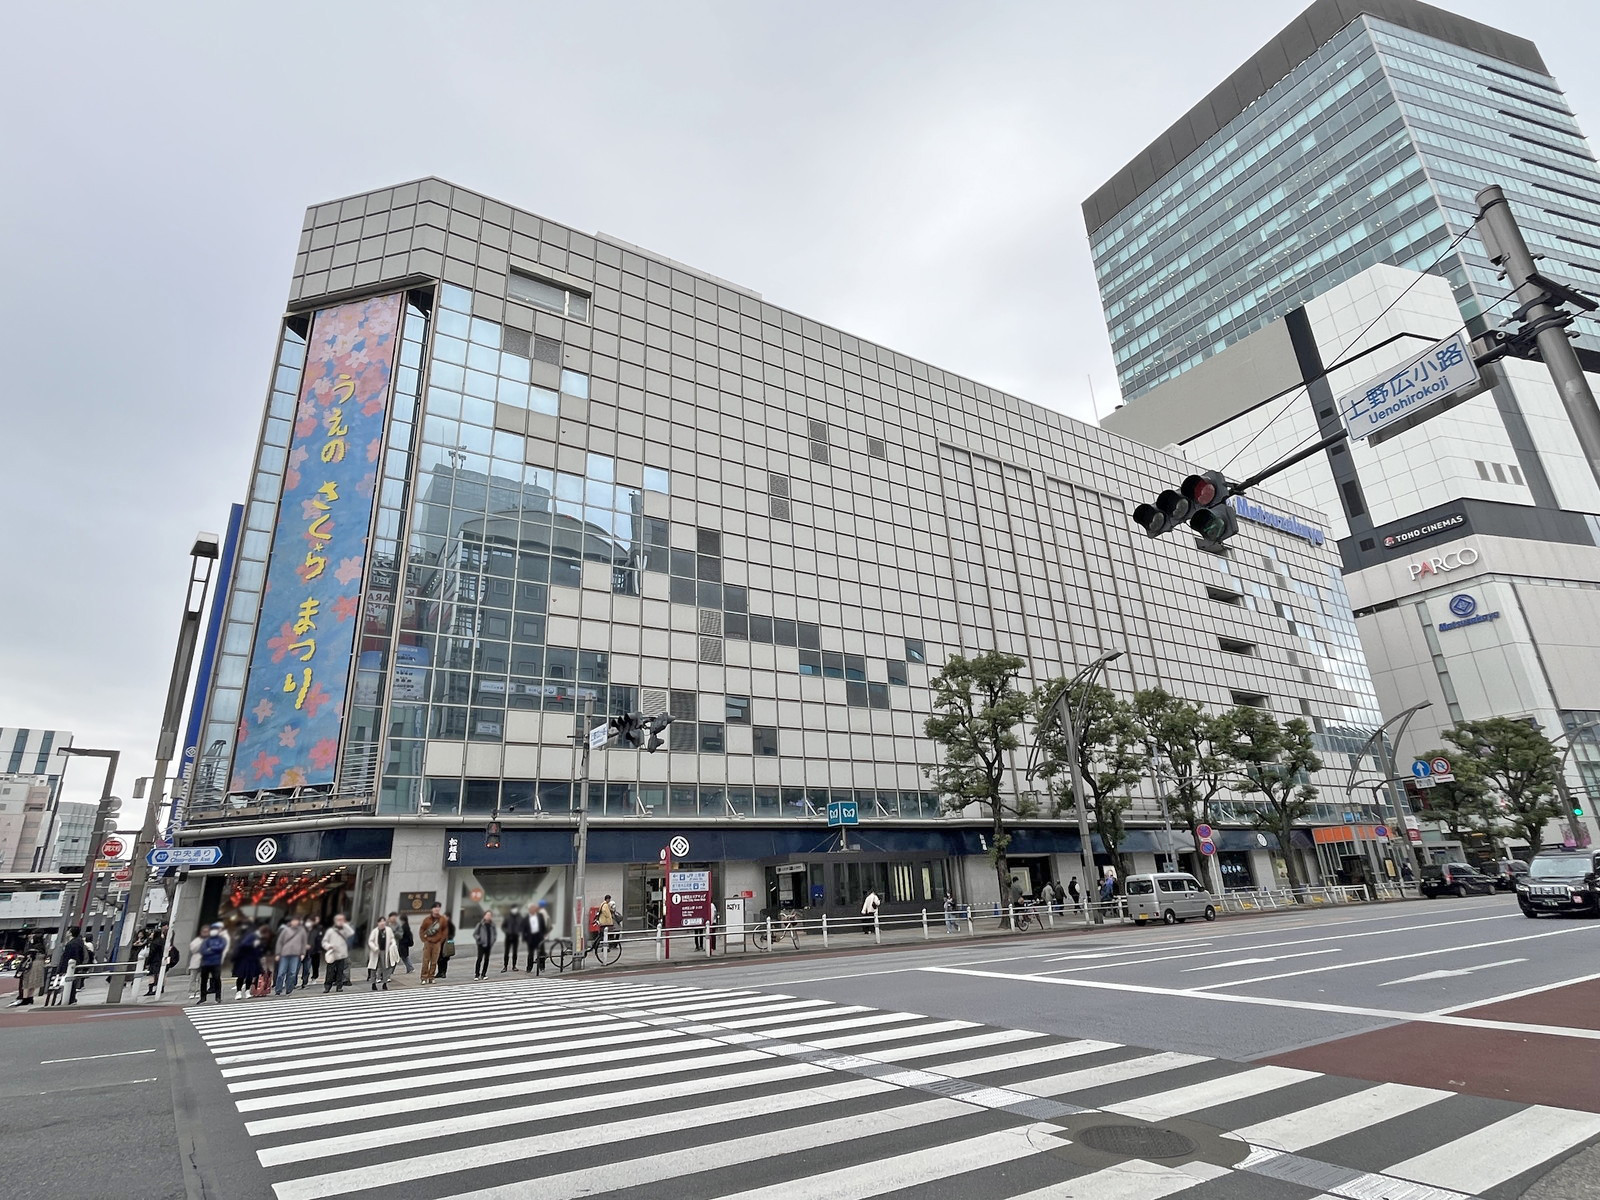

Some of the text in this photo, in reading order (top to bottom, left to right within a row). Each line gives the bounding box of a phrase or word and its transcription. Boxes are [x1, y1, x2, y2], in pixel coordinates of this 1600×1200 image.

[1350, 342, 1463, 420] 上野広小路
[1368, 375, 1449, 424] Uenohirokoji
[283, 373, 356, 711] うえの さくら まつり
[1235, 496, 1325, 548] Matsuzakaya
[1395, 515, 1464, 542] TOHO CINEMAS
[1407, 547, 1479, 581] PARCO
[1438, 611, 1501, 633] Matsuzakaya
[173, 849, 211, 857] 中央通り
